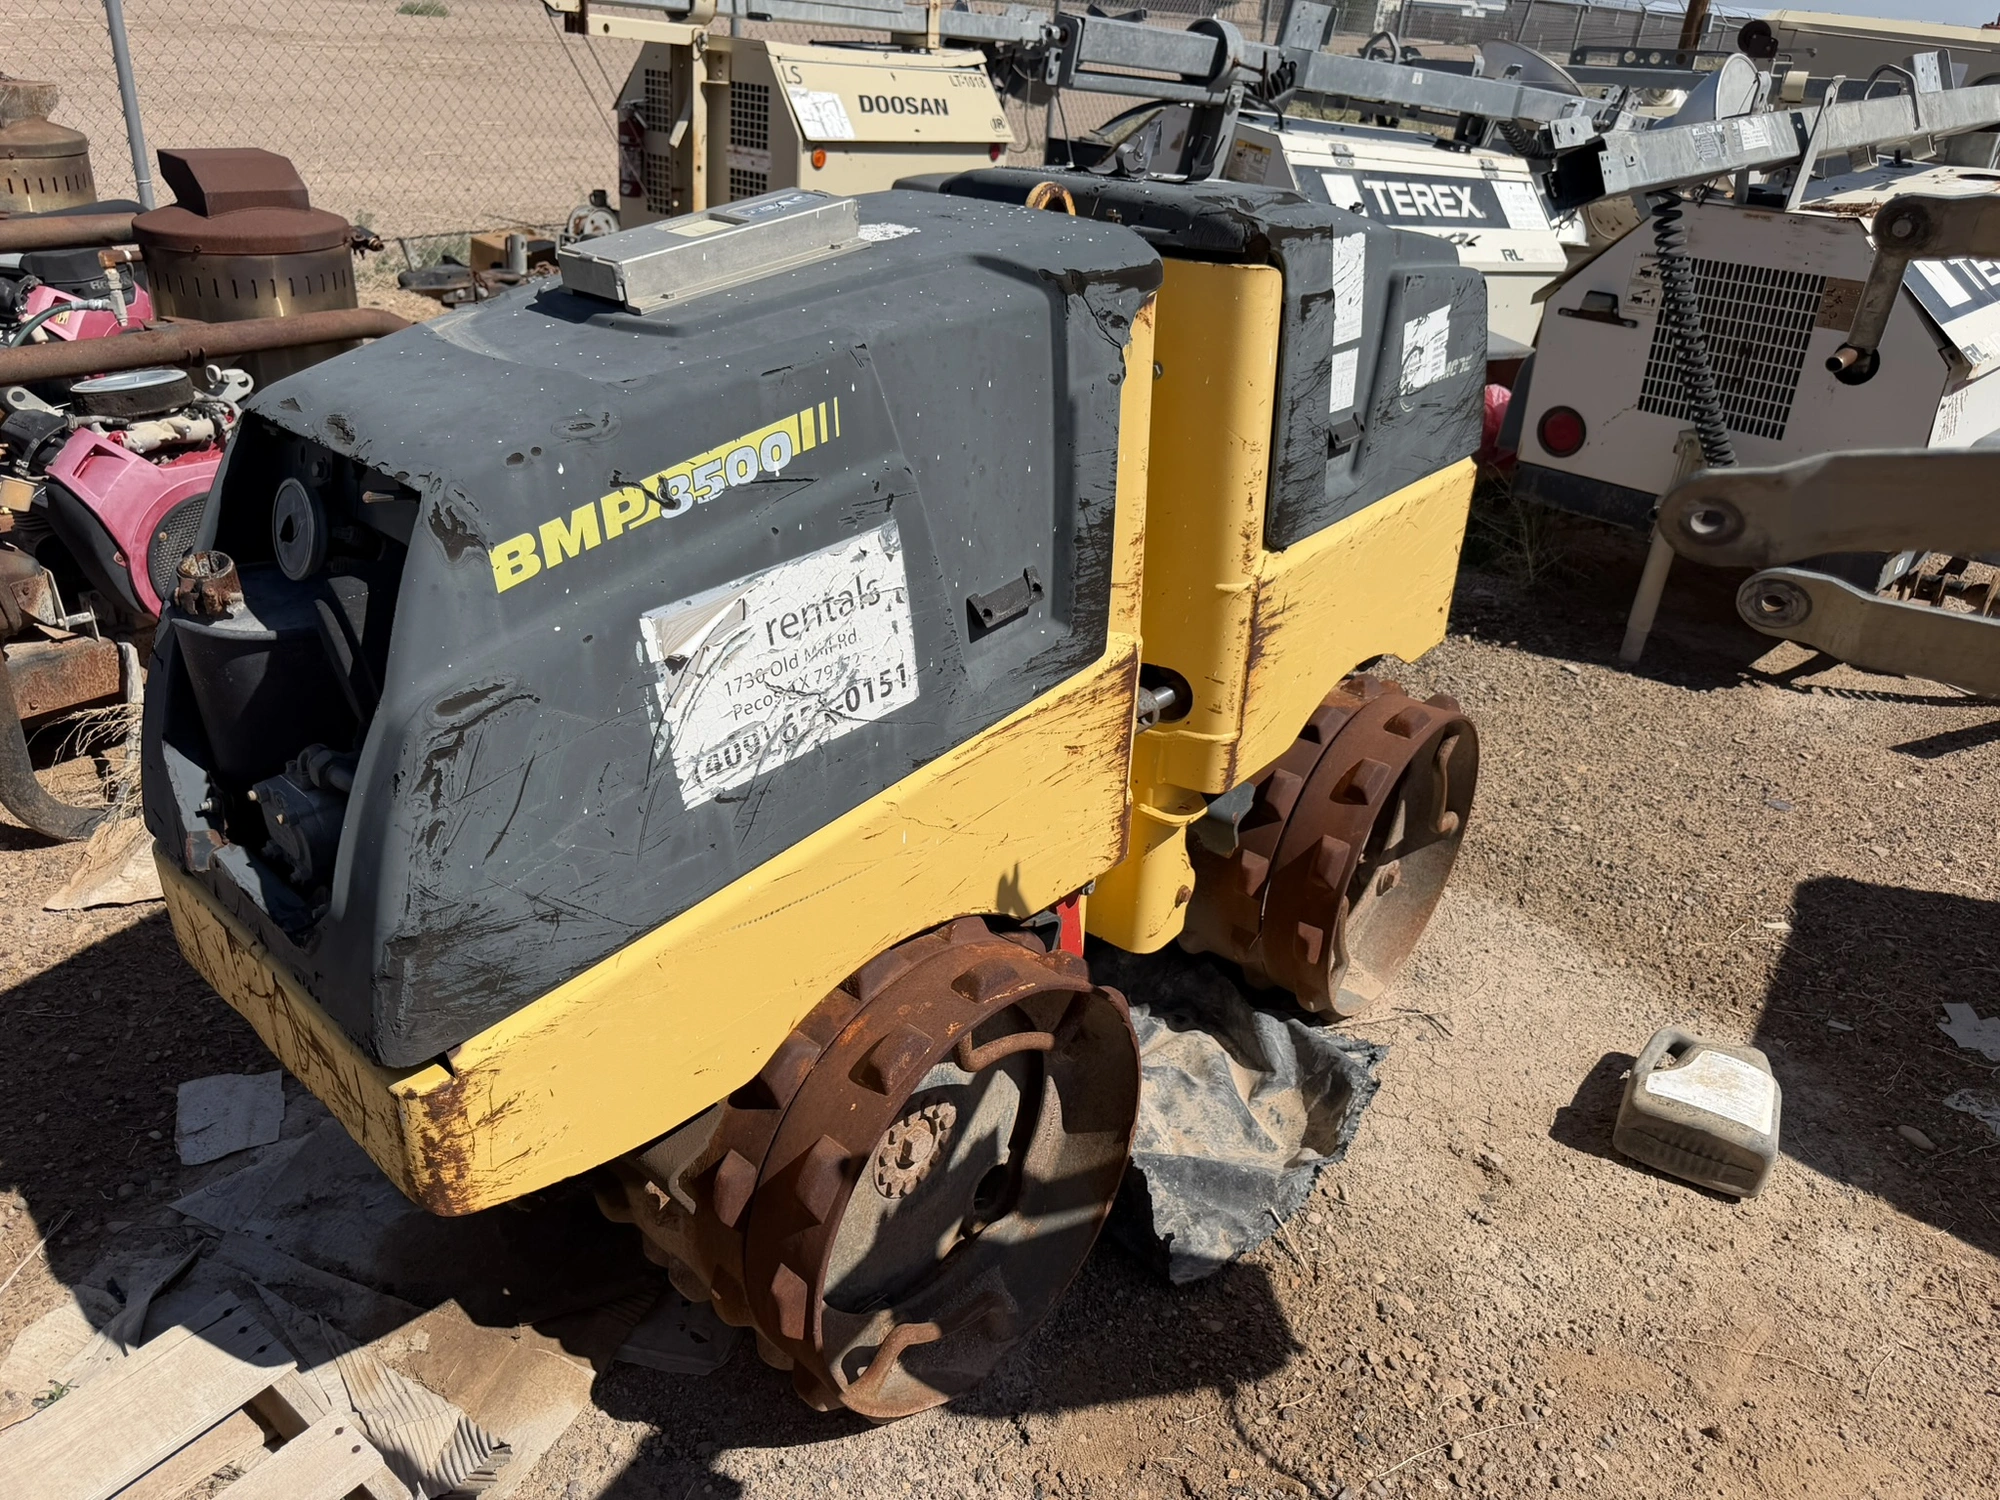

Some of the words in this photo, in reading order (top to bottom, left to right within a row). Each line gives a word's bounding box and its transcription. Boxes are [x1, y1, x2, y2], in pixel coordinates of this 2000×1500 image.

[781, 66, 802, 85] LS
[858, 95, 949, 116] DOOSAN
[1362, 180, 1484, 219] TEREX
[1500, 248, 1524, 261] RL
[1946, 257, 2000, 292] TE
[488, 486, 646, 594] BMP
[658, 431, 793, 519] 8500
[765, 575, 881, 646] rentals
[770, 653, 799, 677] Old
